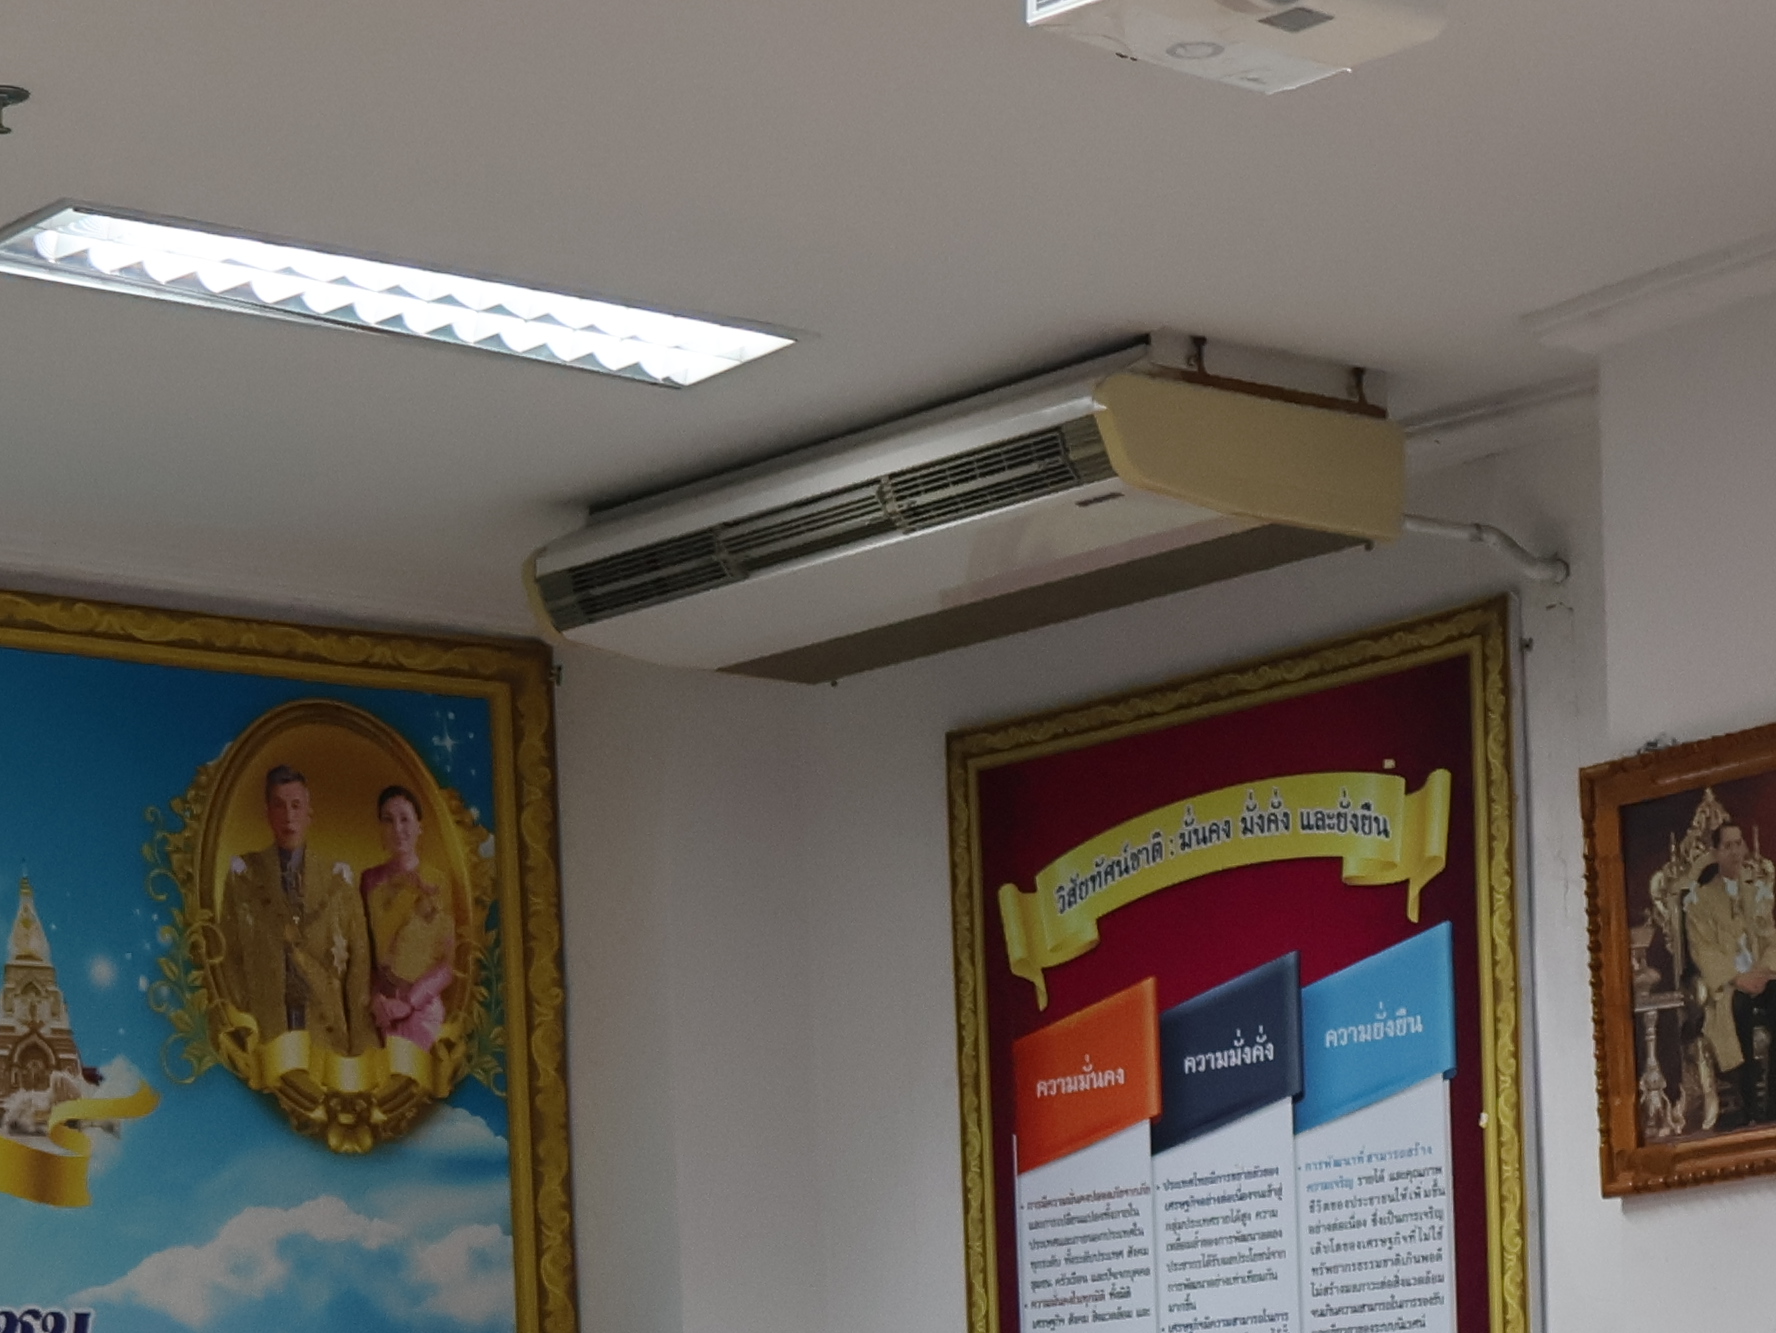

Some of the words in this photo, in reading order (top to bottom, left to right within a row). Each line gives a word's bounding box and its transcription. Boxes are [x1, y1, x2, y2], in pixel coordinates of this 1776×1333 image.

[1055, 830, 1164, 914] วิสัยทัศน์ชาติ
[1179, 806, 1231, 851] มั่นคง
[1240, 789, 1290, 837] มั่งคั่ง
[1300, 787, 1390, 839] และยั่งยืน
[1325, 1002, 1423, 1048] ความยั่งยืน
[1184, 1025, 1274, 1074] ความมั่งคั่ง
[1036, 1054, 1124, 1098] ความมั่นคง
